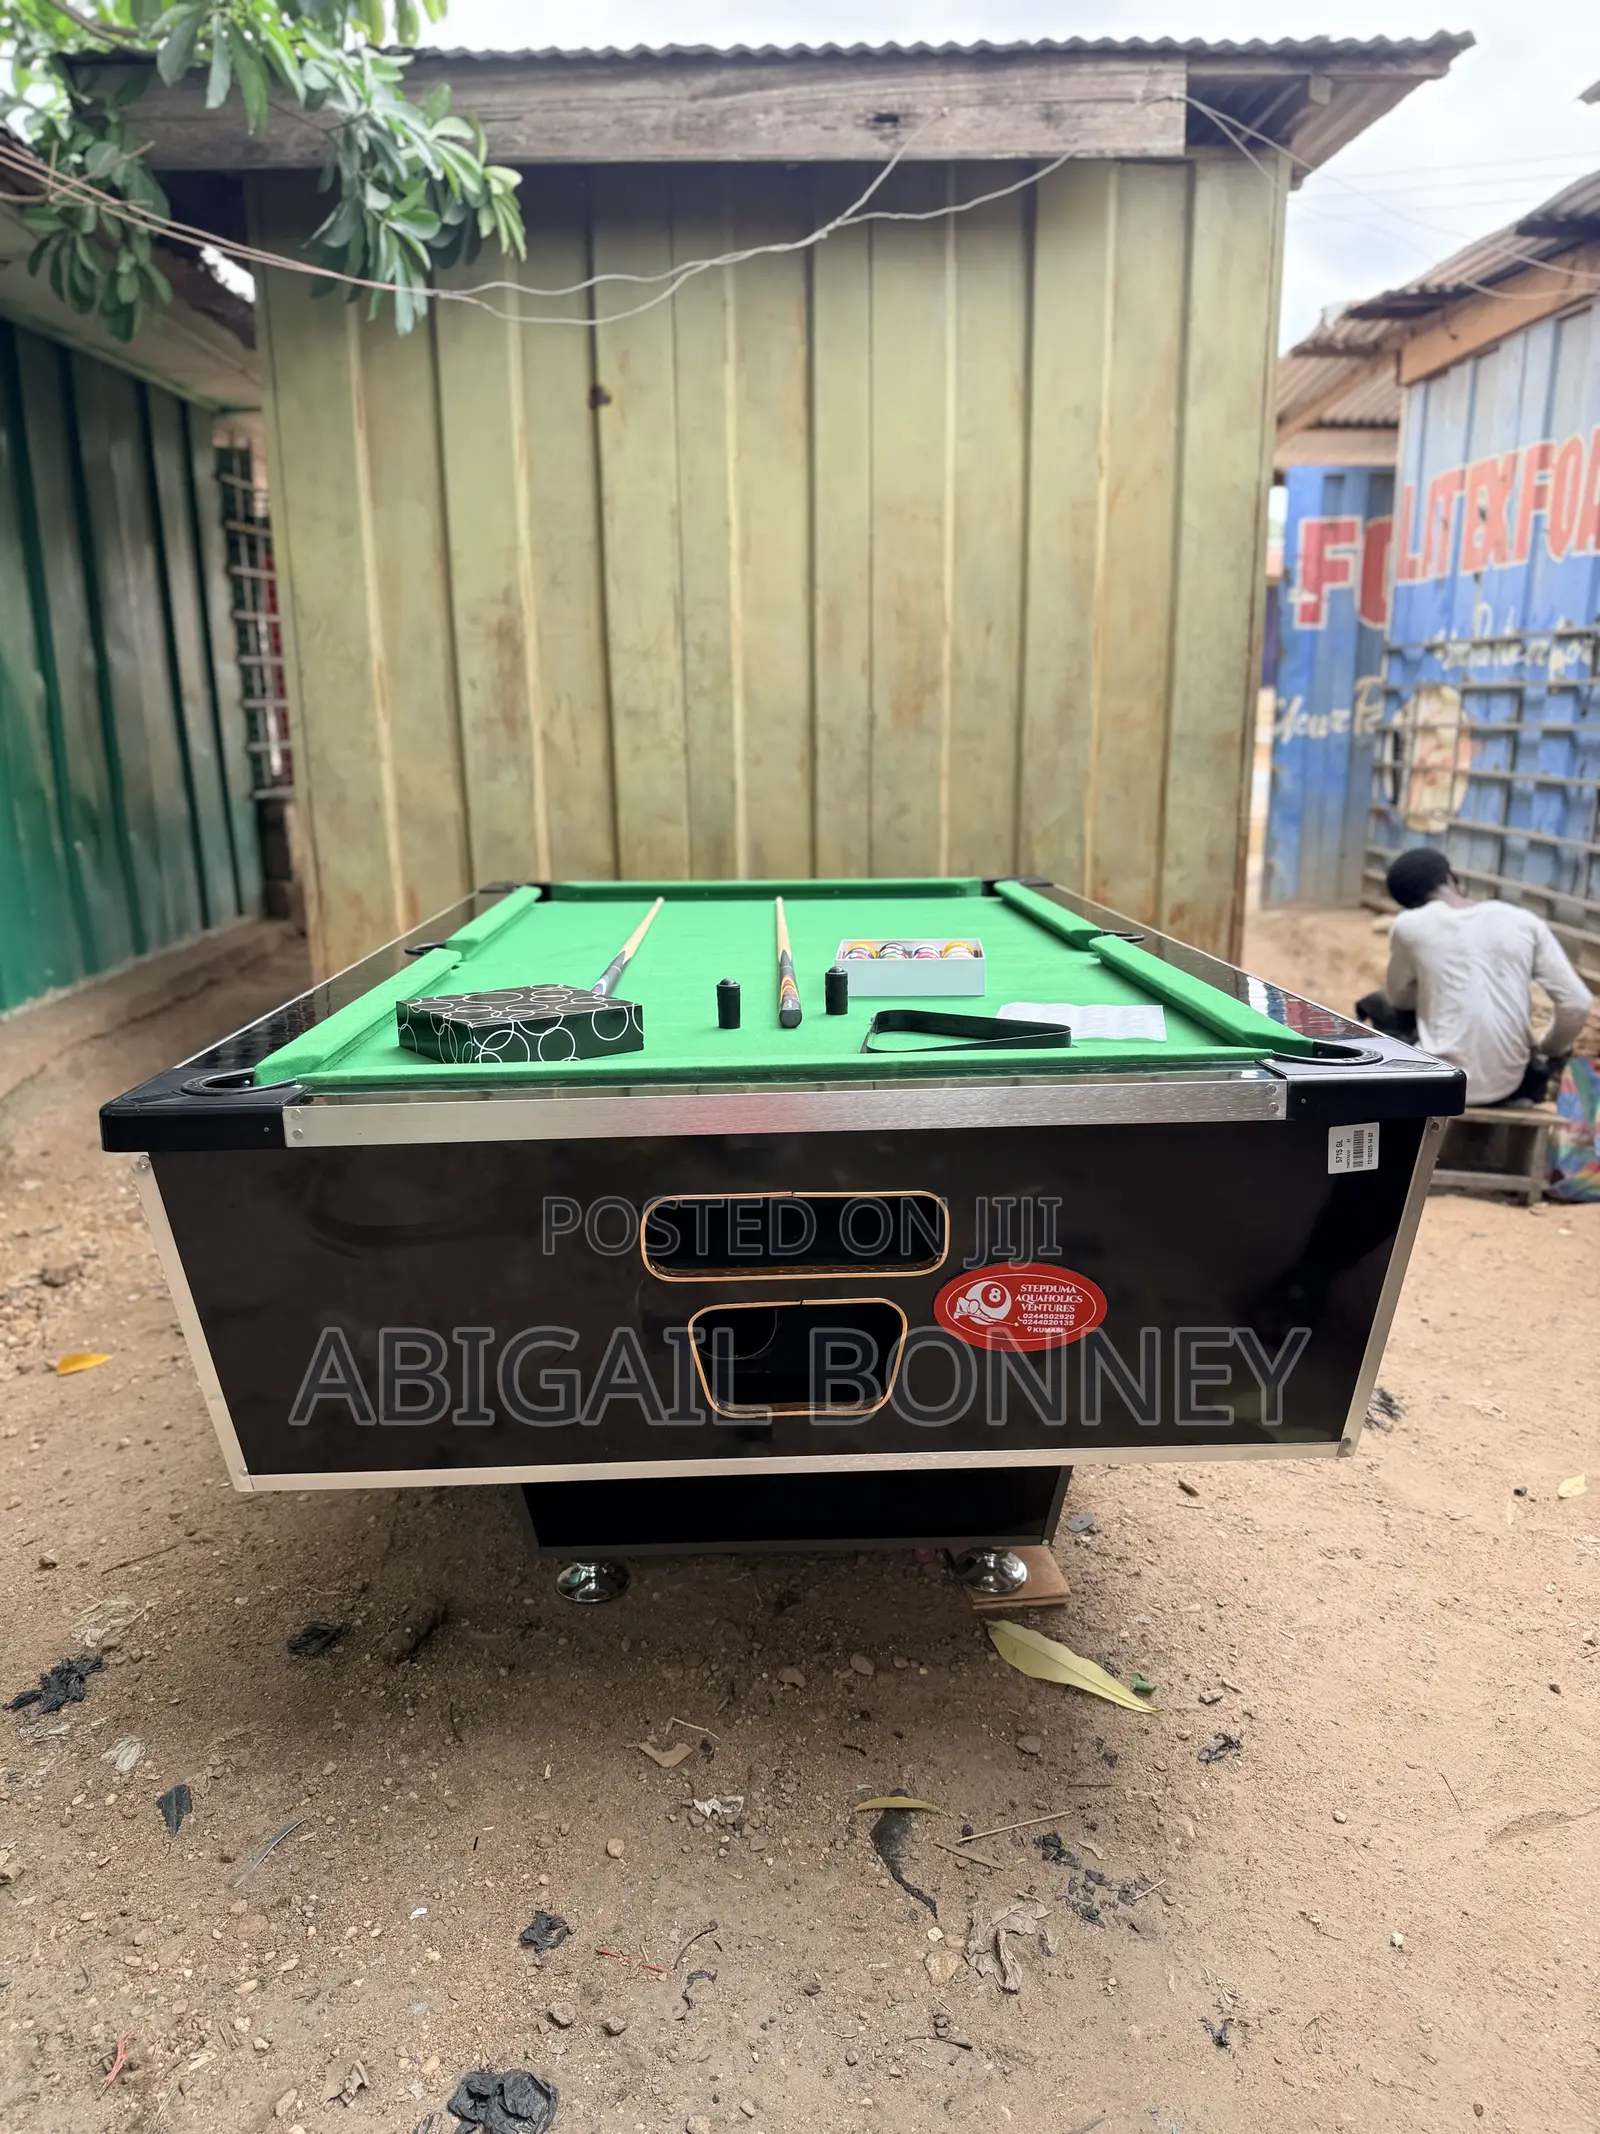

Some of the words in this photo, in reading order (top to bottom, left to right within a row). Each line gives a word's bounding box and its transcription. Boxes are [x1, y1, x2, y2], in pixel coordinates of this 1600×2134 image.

[1020, 1283, 1077, 1294] STEPDUMA
[988, 1287, 1002, 1303] 8
[1014, 1293, 1083, 1305] AQUAHOLICS
[1021, 1303, 1076, 1313] VENTURES
[1032, 1326, 1064, 1334] KUMASI
